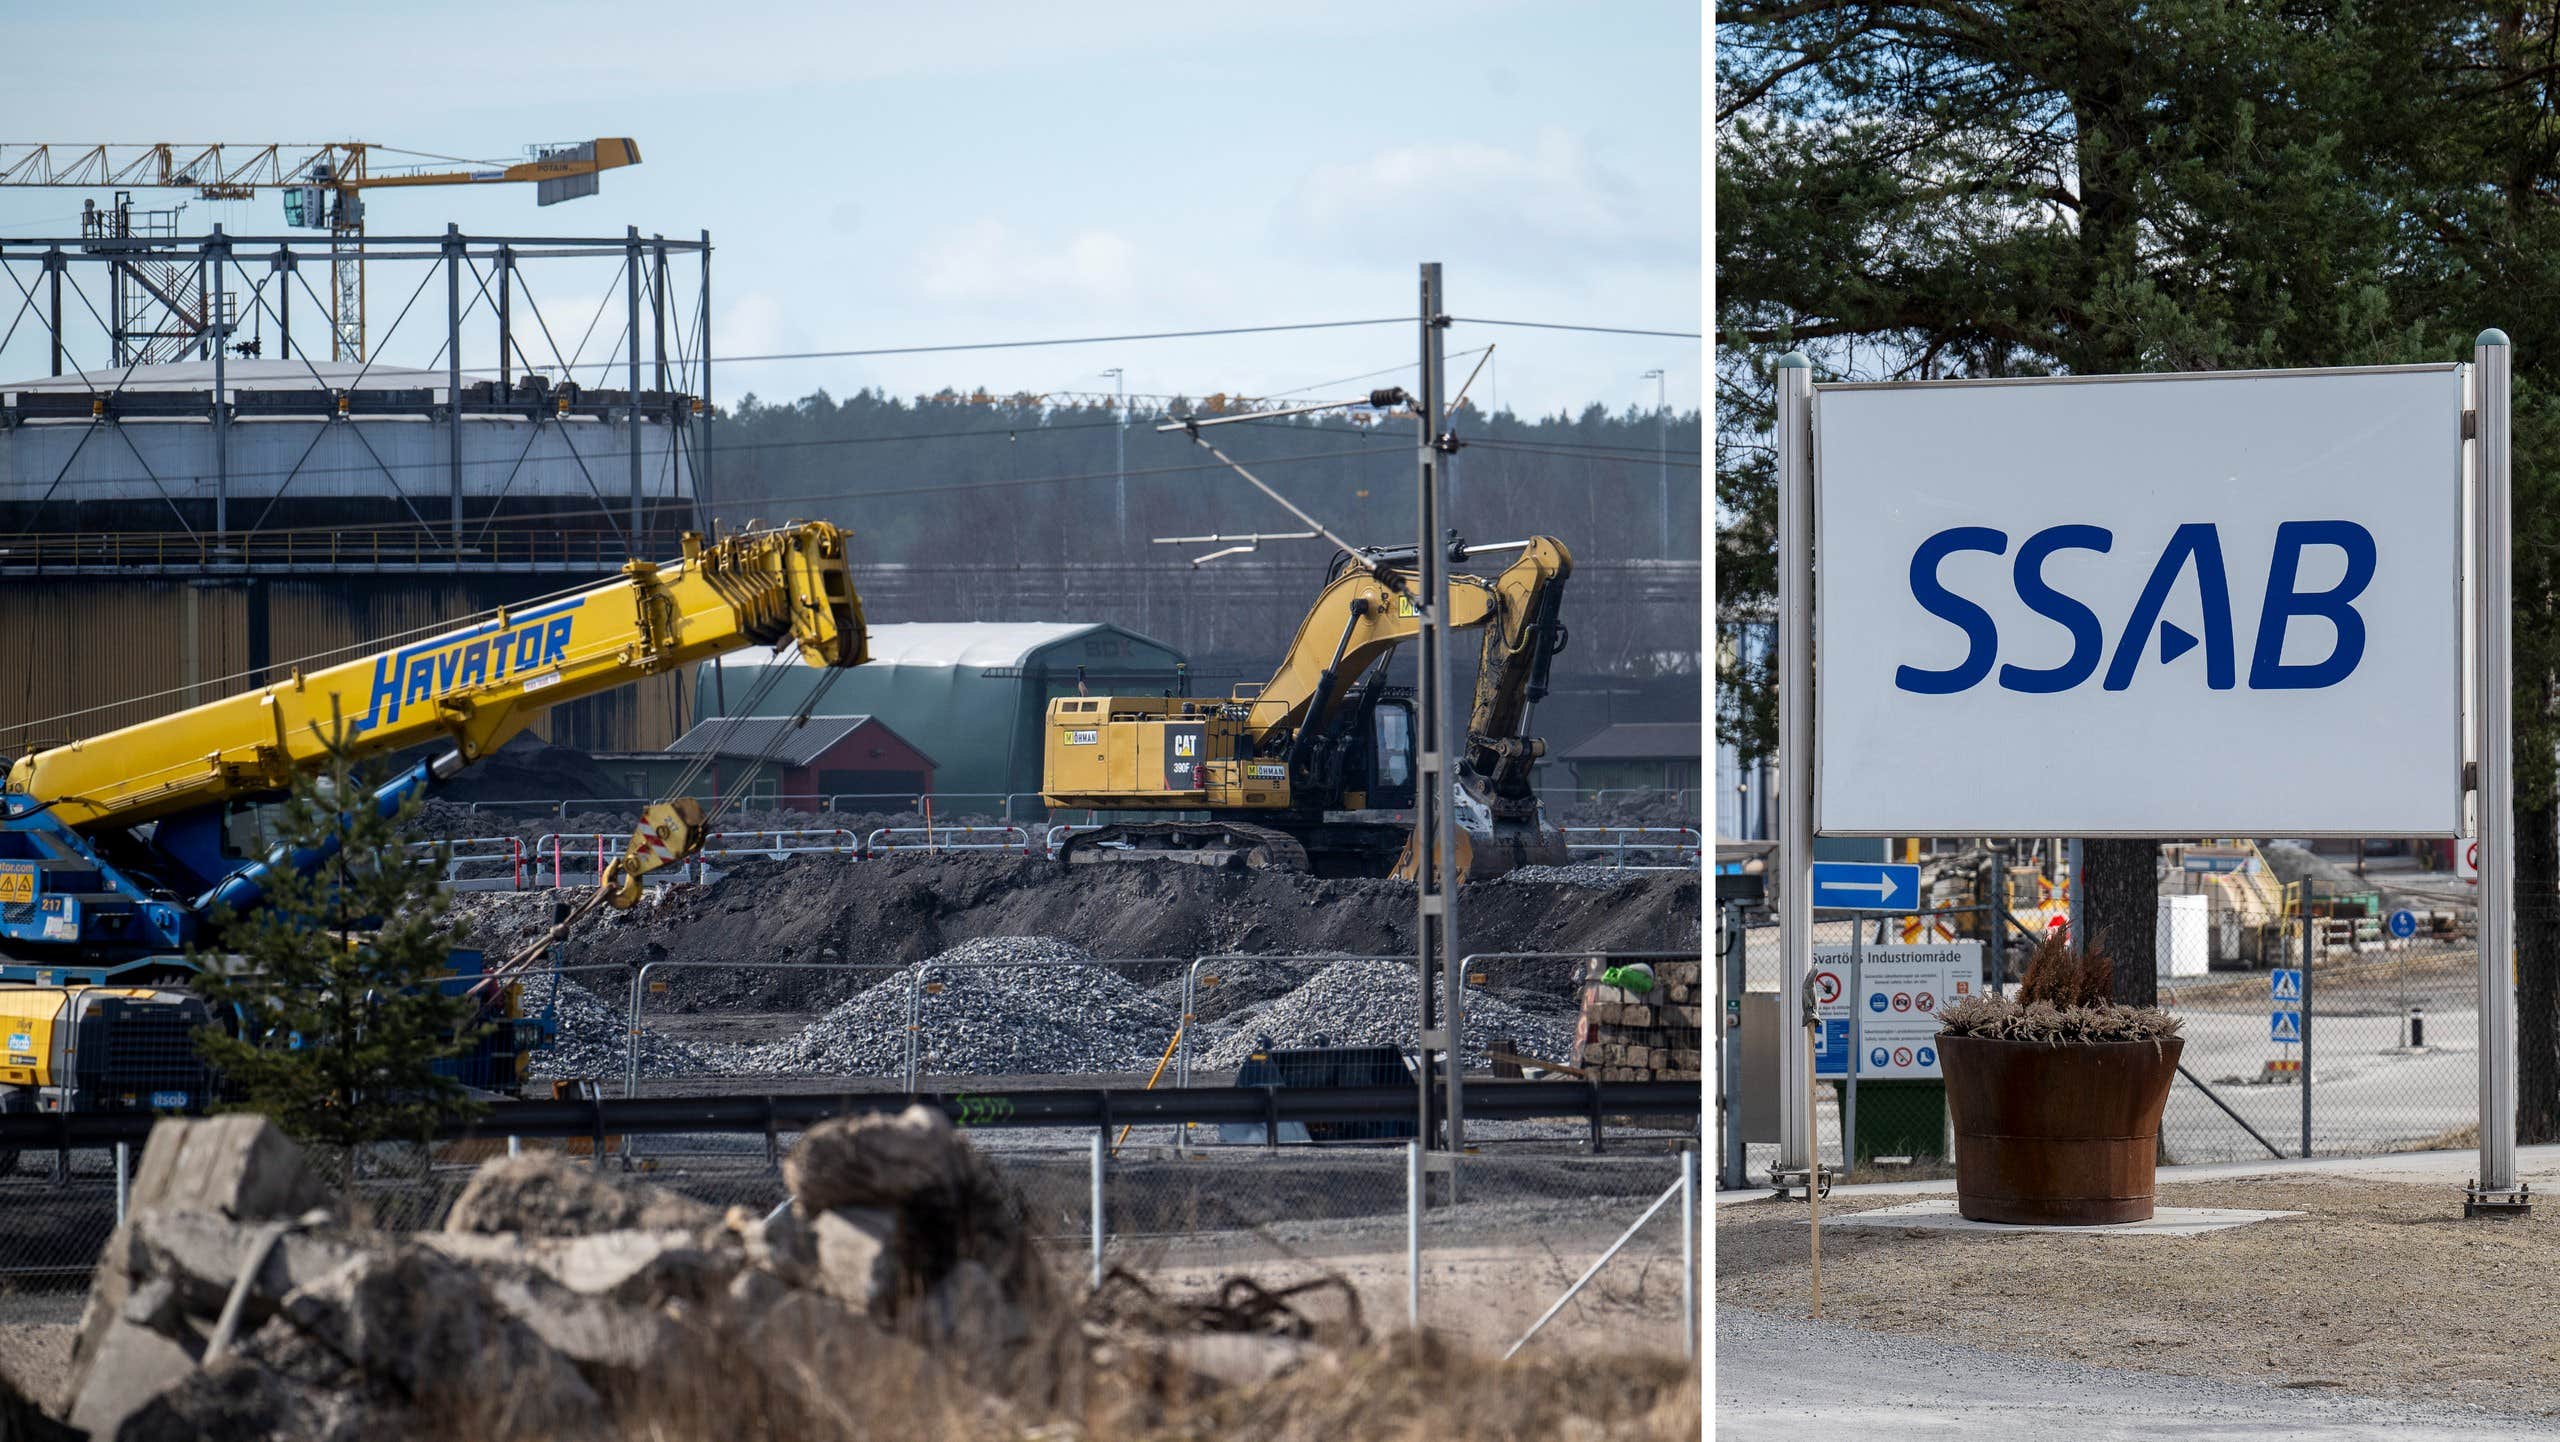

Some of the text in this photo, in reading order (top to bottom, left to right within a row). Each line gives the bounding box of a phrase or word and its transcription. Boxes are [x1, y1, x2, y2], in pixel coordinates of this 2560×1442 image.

[1894, 519, 2377, 694] SSAB
[355, 599, 584, 731] HAVATOR
[1174, 735, 1197, 757] CAT
[41, 898, 62, 911] 217
[1868, 950, 1962, 964] Industriområde
[153, 1091, 187, 1106] itsab
